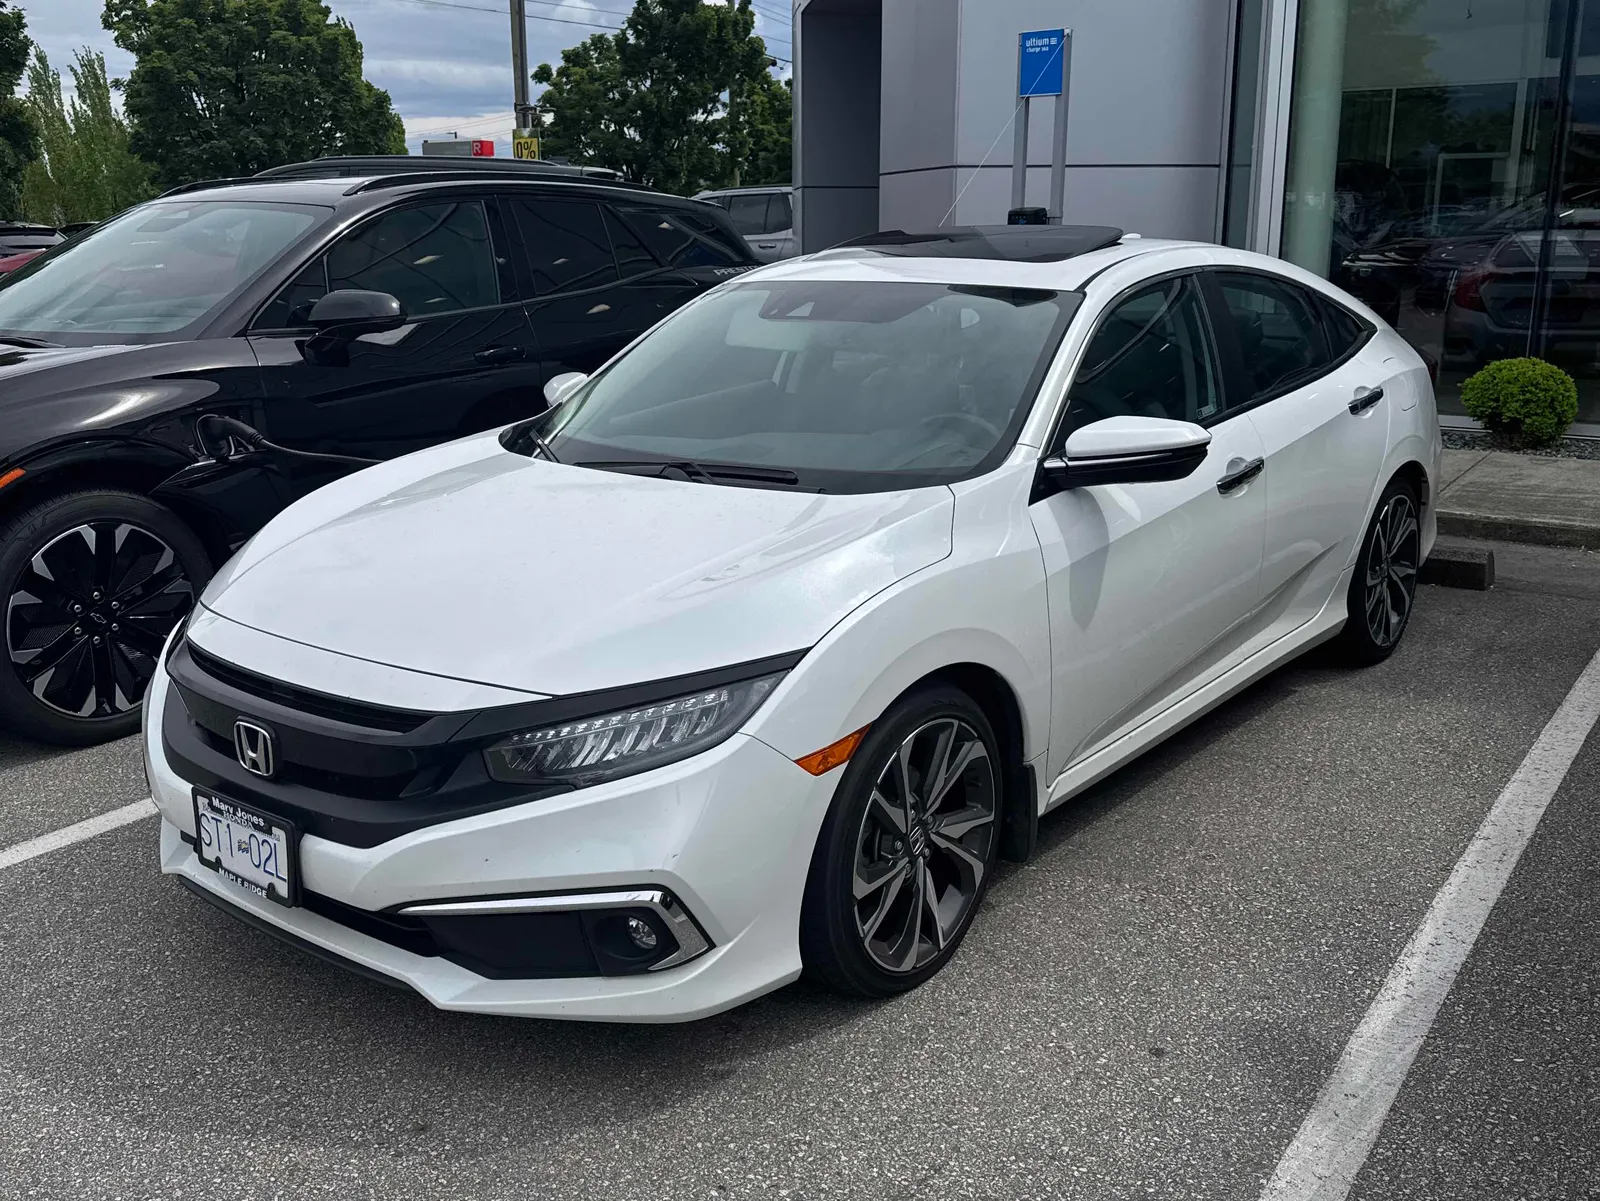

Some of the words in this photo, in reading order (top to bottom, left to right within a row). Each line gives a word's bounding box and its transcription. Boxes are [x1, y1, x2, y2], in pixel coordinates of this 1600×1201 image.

[1026, 38, 1049, 47] ultium
[473, 142, 482, 153] R
[516, 140, 536, 160] 0%
[222, 810, 254, 831] HONDA
[236, 807, 264, 827] Jones
[218, 867, 243, 885] MAPLE
[244, 881, 268, 899] RIDGE
